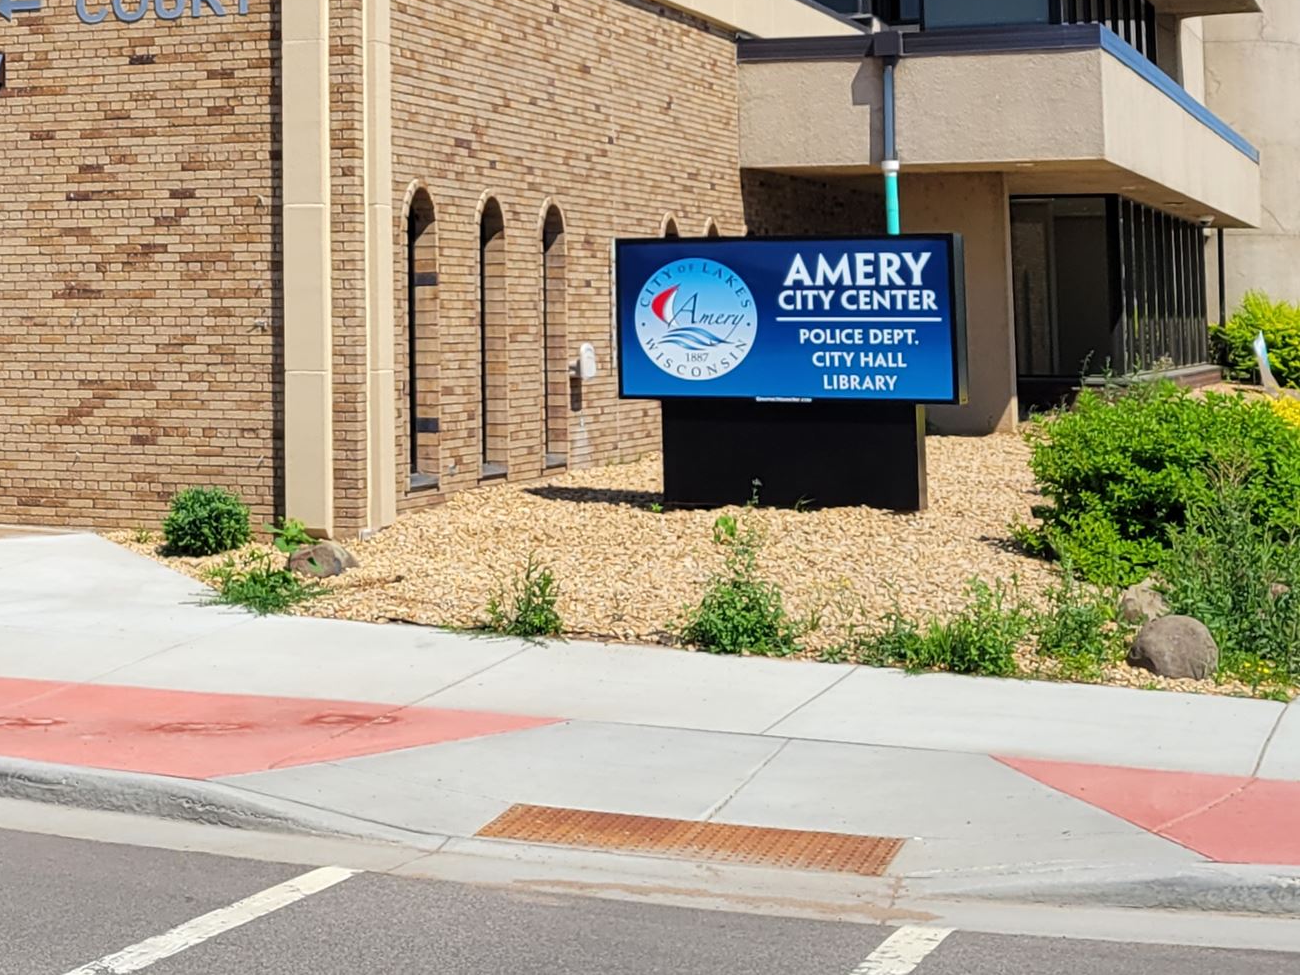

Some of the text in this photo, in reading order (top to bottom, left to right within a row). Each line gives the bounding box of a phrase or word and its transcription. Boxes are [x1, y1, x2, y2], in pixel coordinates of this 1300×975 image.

[783, 252, 932, 287] AMERY
[640, 268, 673, 308] CITY
[702, 262, 752, 309] LAKES
[778, 289, 938, 311] CITY CENTER
[668, 292, 745, 341] Amery
[799, 328, 919, 345] POLICE DEPT.
[645, 338, 748, 377] WISCONSIN
[685, 353, 709, 363] 1887
[812, 351, 907, 368] CITY HALL
[823, 375, 898, 391] LIBRARY
